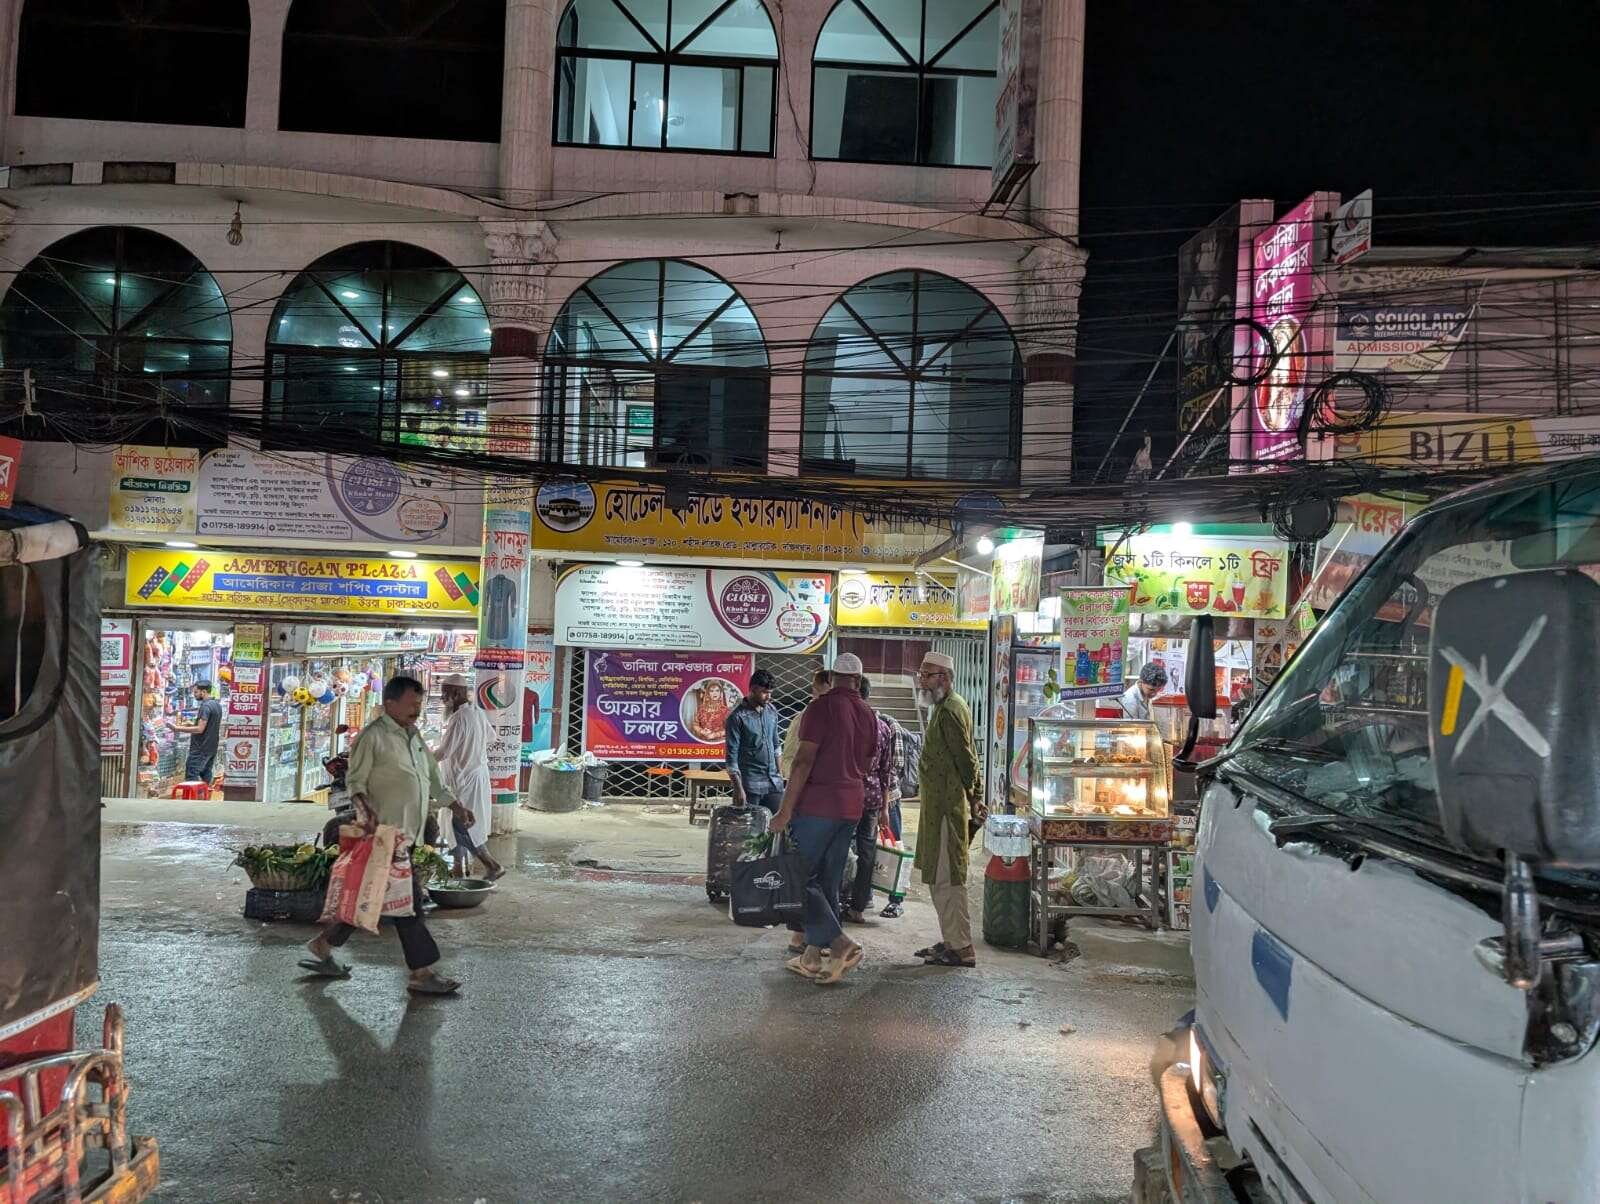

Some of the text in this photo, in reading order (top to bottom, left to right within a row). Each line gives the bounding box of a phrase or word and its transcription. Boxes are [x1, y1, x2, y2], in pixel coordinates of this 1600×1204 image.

[1262, 219, 1301, 262] তানিয়া
[1346, 341, 1425, 353] ADMISSION
[115, 451, 196, 475] আশিক জুয়েলার্স
[208, 521, 265, 531] 01758-189914
[223, 558, 417, 579] AMERICAN PLAZA
[1142, 550, 1165, 570] ১টি
[1170, 550, 1213, 570] কিনলে
[1218, 552, 1242, 571] ১টি
[1248, 549, 1282, 581] ফ্রি
[222, 576, 422, 596] আমেরিকান প্লাজা শপিং সেন্টার
[726, 592, 767, 603] CLOSET
[576, 631, 625, 641] 01758-189914
[622, 659, 743, 673] তানিয়া মেকওভার জোন
[239, 681, 259, 694] বিল
[229, 689, 264, 703] বিকাশ
[232, 702, 259, 712] করুন
[597, 693, 662, 719] অফার
[623, 719, 679, 741] চলছে
[228, 759, 257, 772] নগদ
